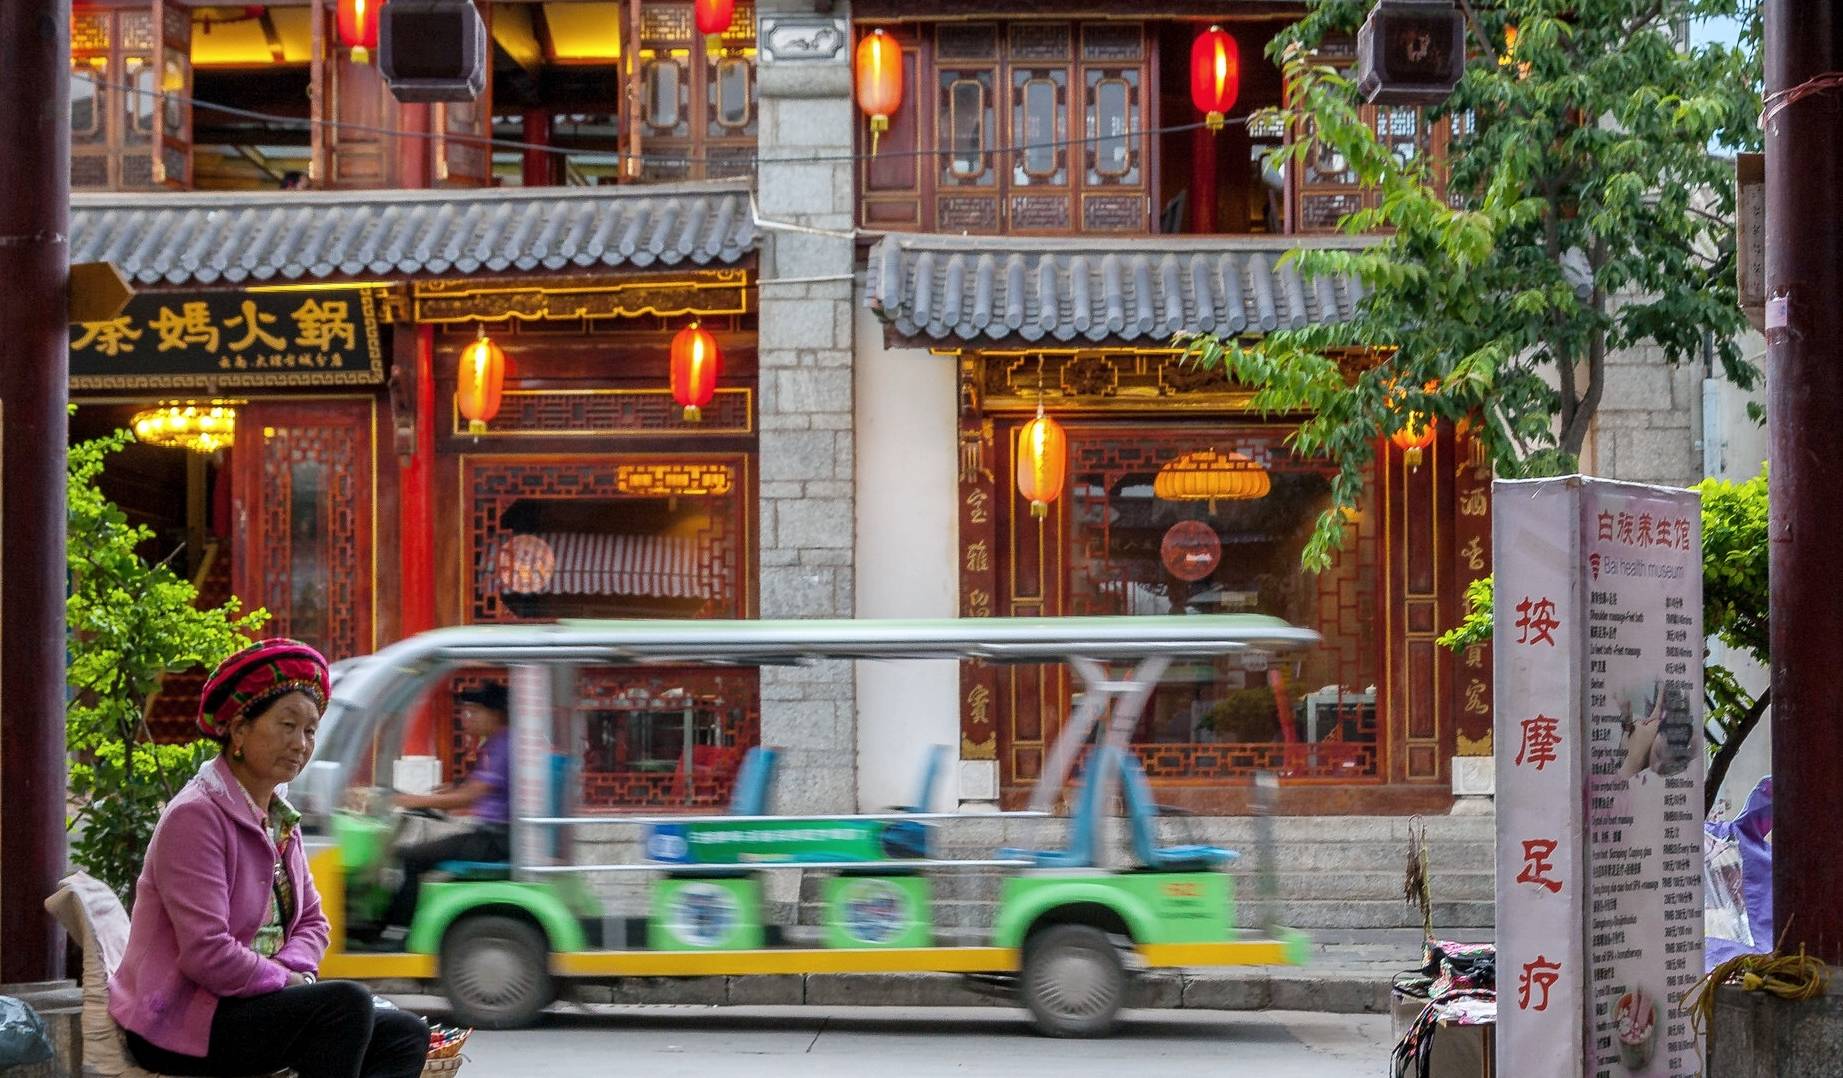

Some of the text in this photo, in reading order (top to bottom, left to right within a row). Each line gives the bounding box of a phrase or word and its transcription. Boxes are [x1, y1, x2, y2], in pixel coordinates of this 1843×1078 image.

[1598, 509, 1690, 551] 白族养生馆
[1515, 596, 1562, 1012] 按摩足疗
